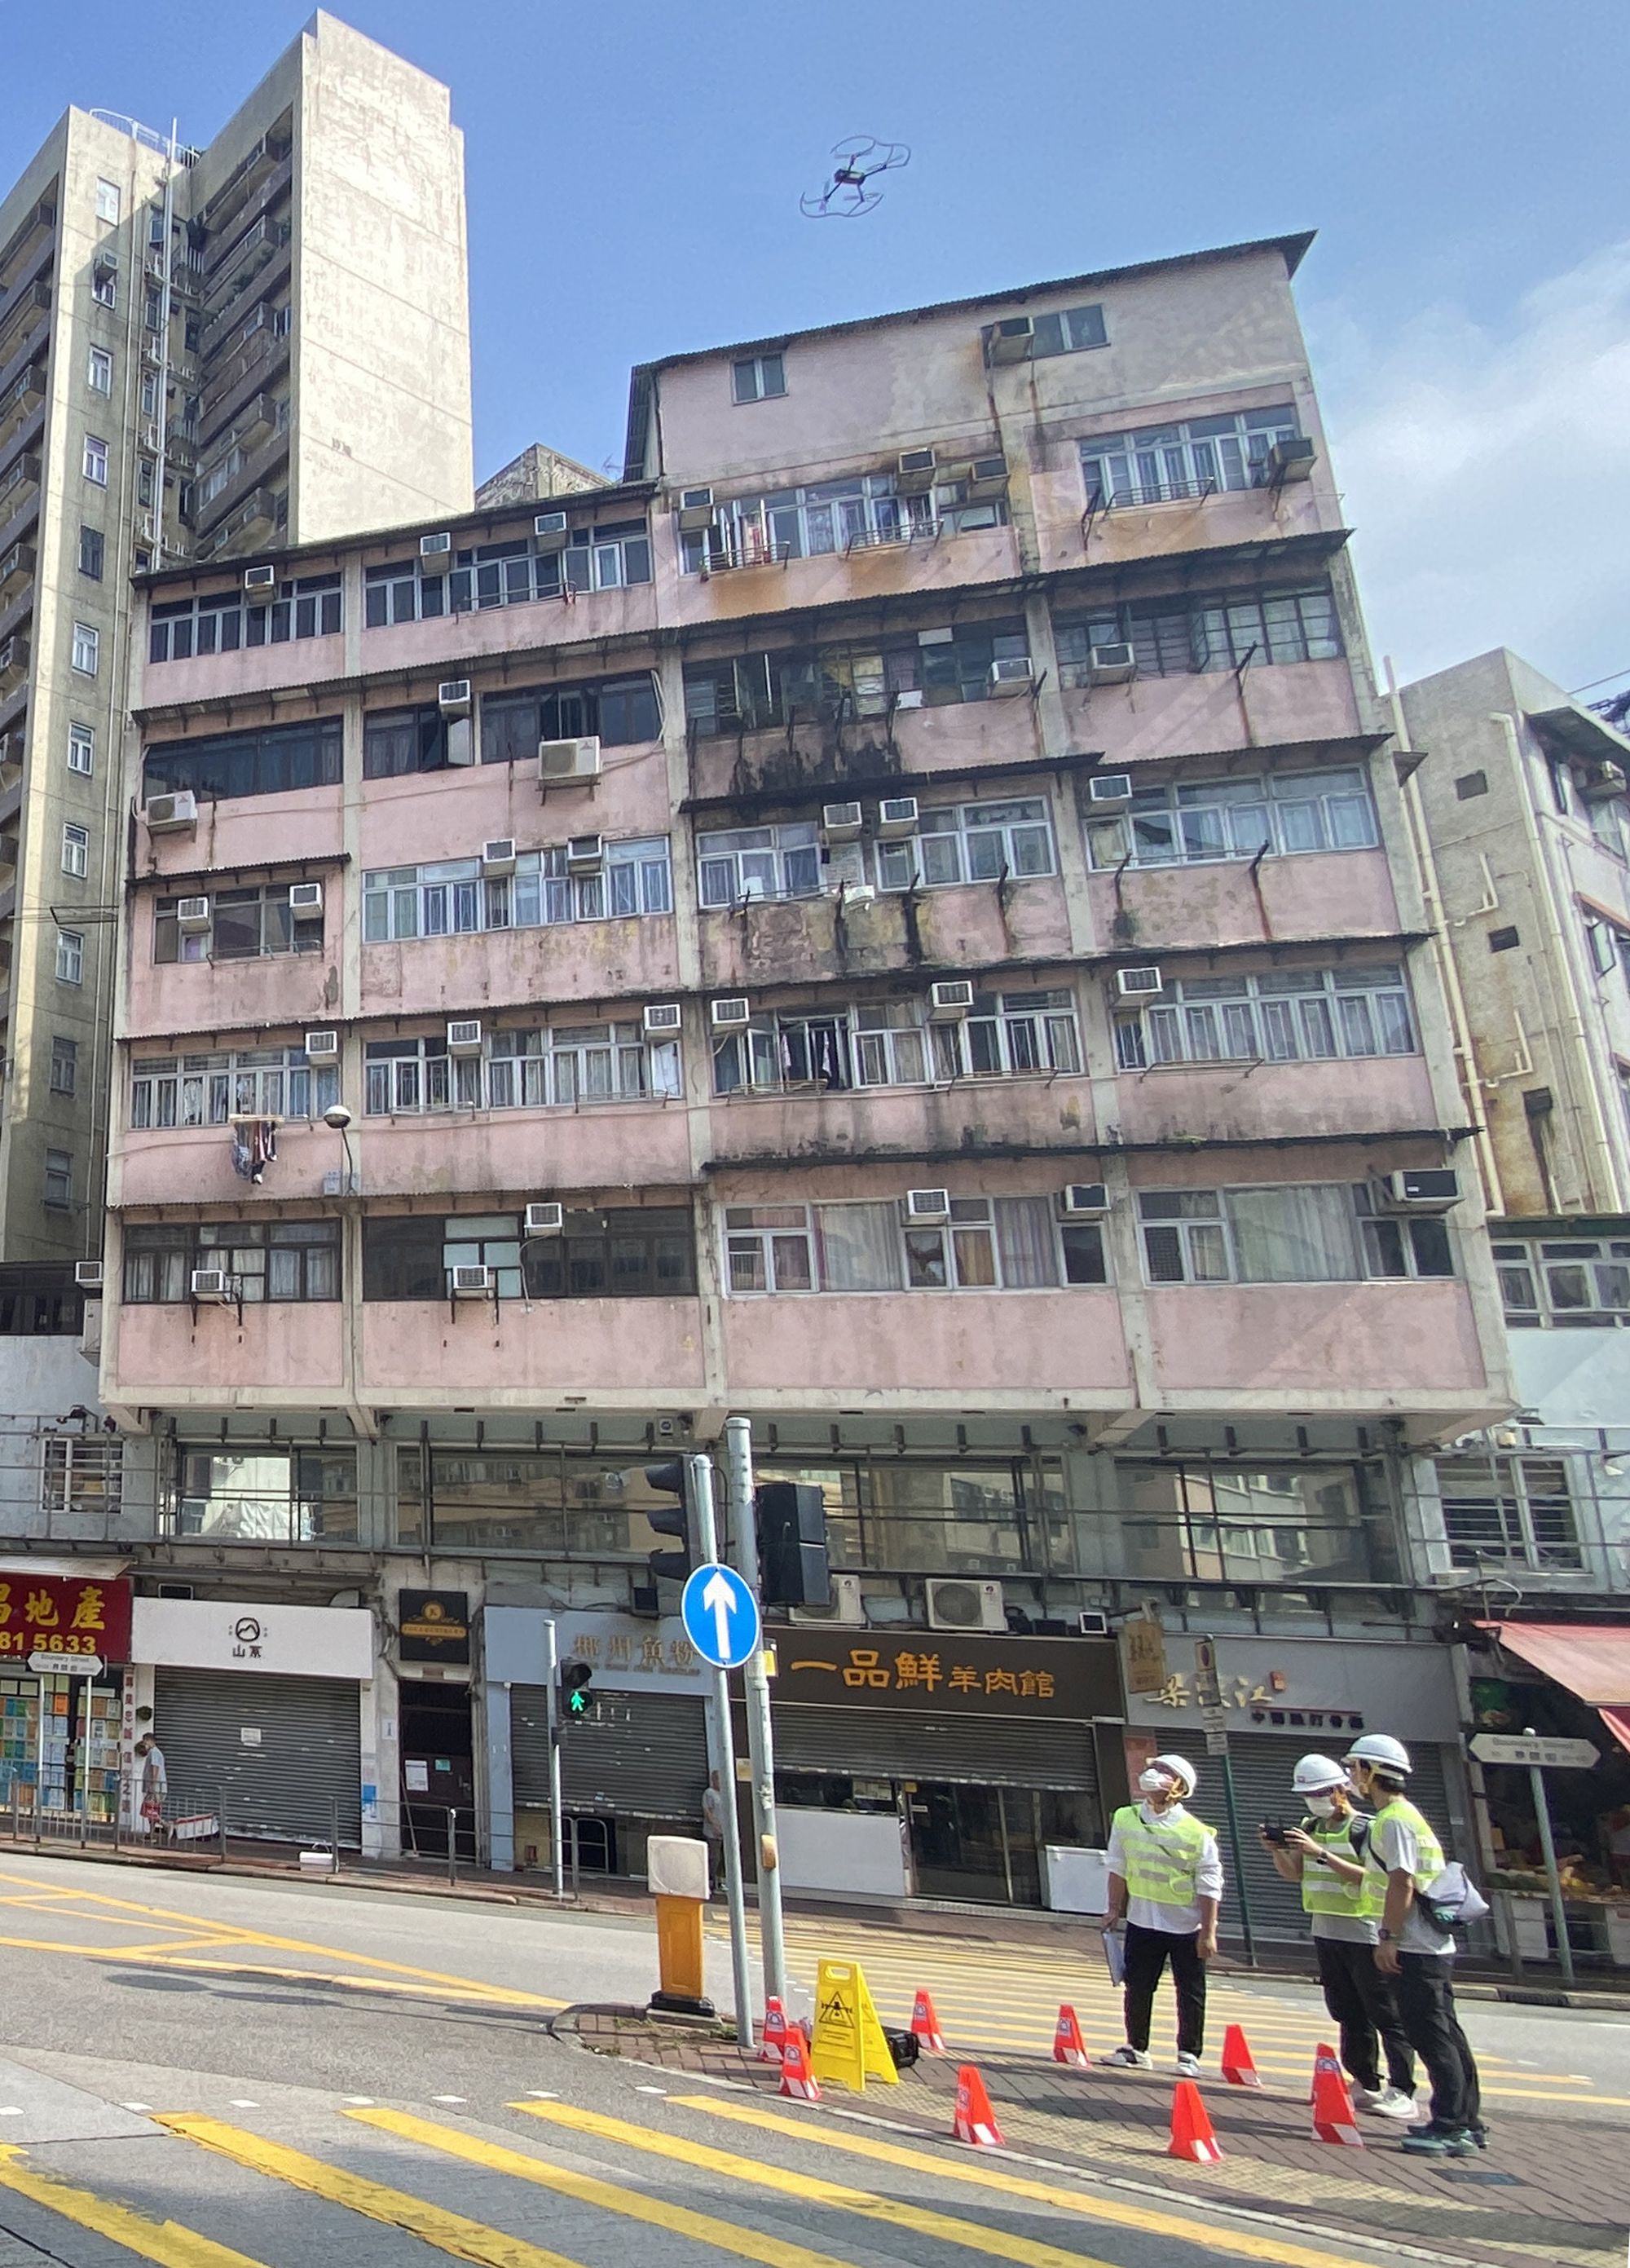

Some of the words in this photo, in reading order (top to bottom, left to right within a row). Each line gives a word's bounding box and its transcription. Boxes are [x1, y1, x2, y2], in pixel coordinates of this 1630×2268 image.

[33, 1633, 96, 1655] 5633
[791, 1648, 1055, 1698] 一品鮮羊肉館
